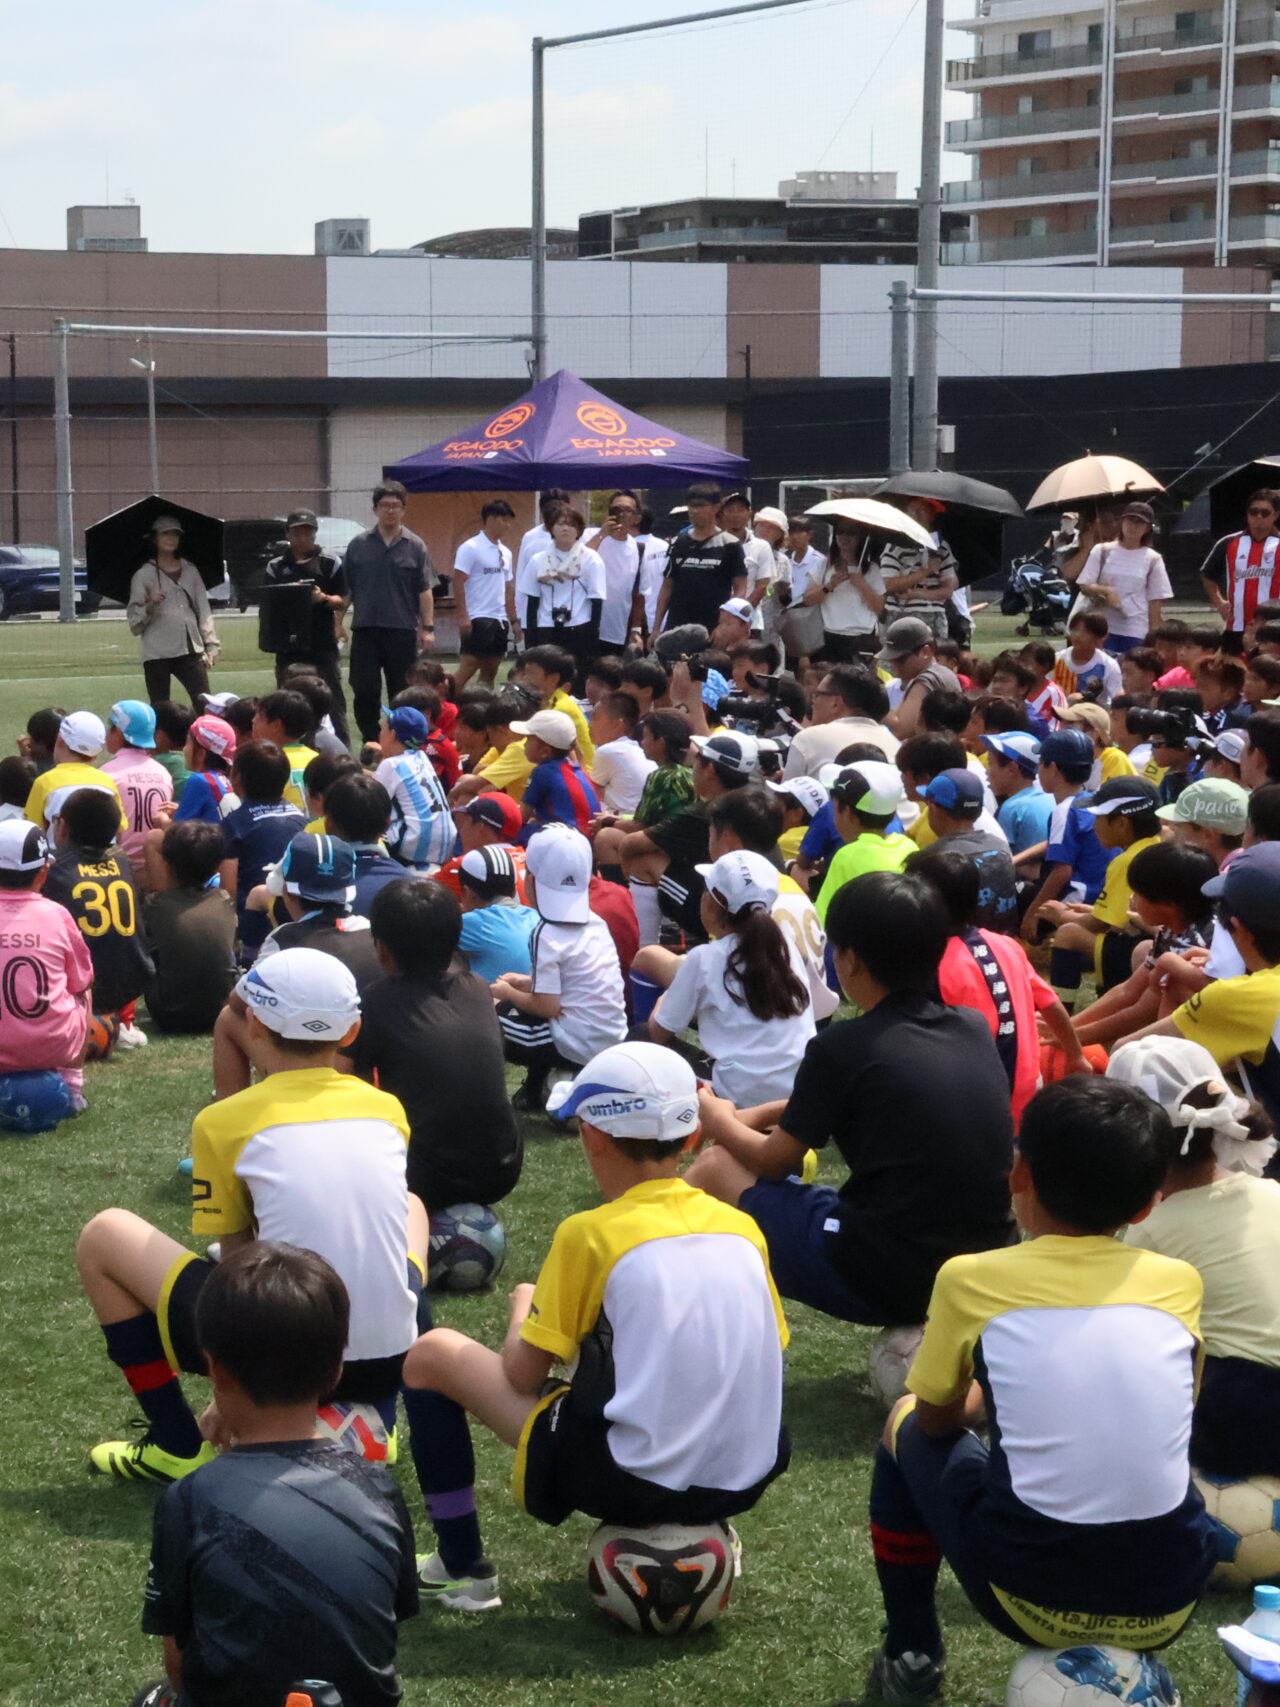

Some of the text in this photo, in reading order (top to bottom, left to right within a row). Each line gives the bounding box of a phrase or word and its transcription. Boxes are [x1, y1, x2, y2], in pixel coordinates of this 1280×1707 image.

[442, 440, 524, 451] EGAODO
[570, 437, 677, 449] EGAODO
[597, 449, 651, 457] JAPAN
[127, 772, 166, 785] MESSI
[127, 786, 168, 832] 10
[77, 858, 121, 878] MESSI
[71, 879, 136, 938] 30
[587, 1098, 647, 1117] umbro
[1059, 1629, 1116, 1642] SOCCER
[1121, 1626, 1173, 1643] SCHOOL
